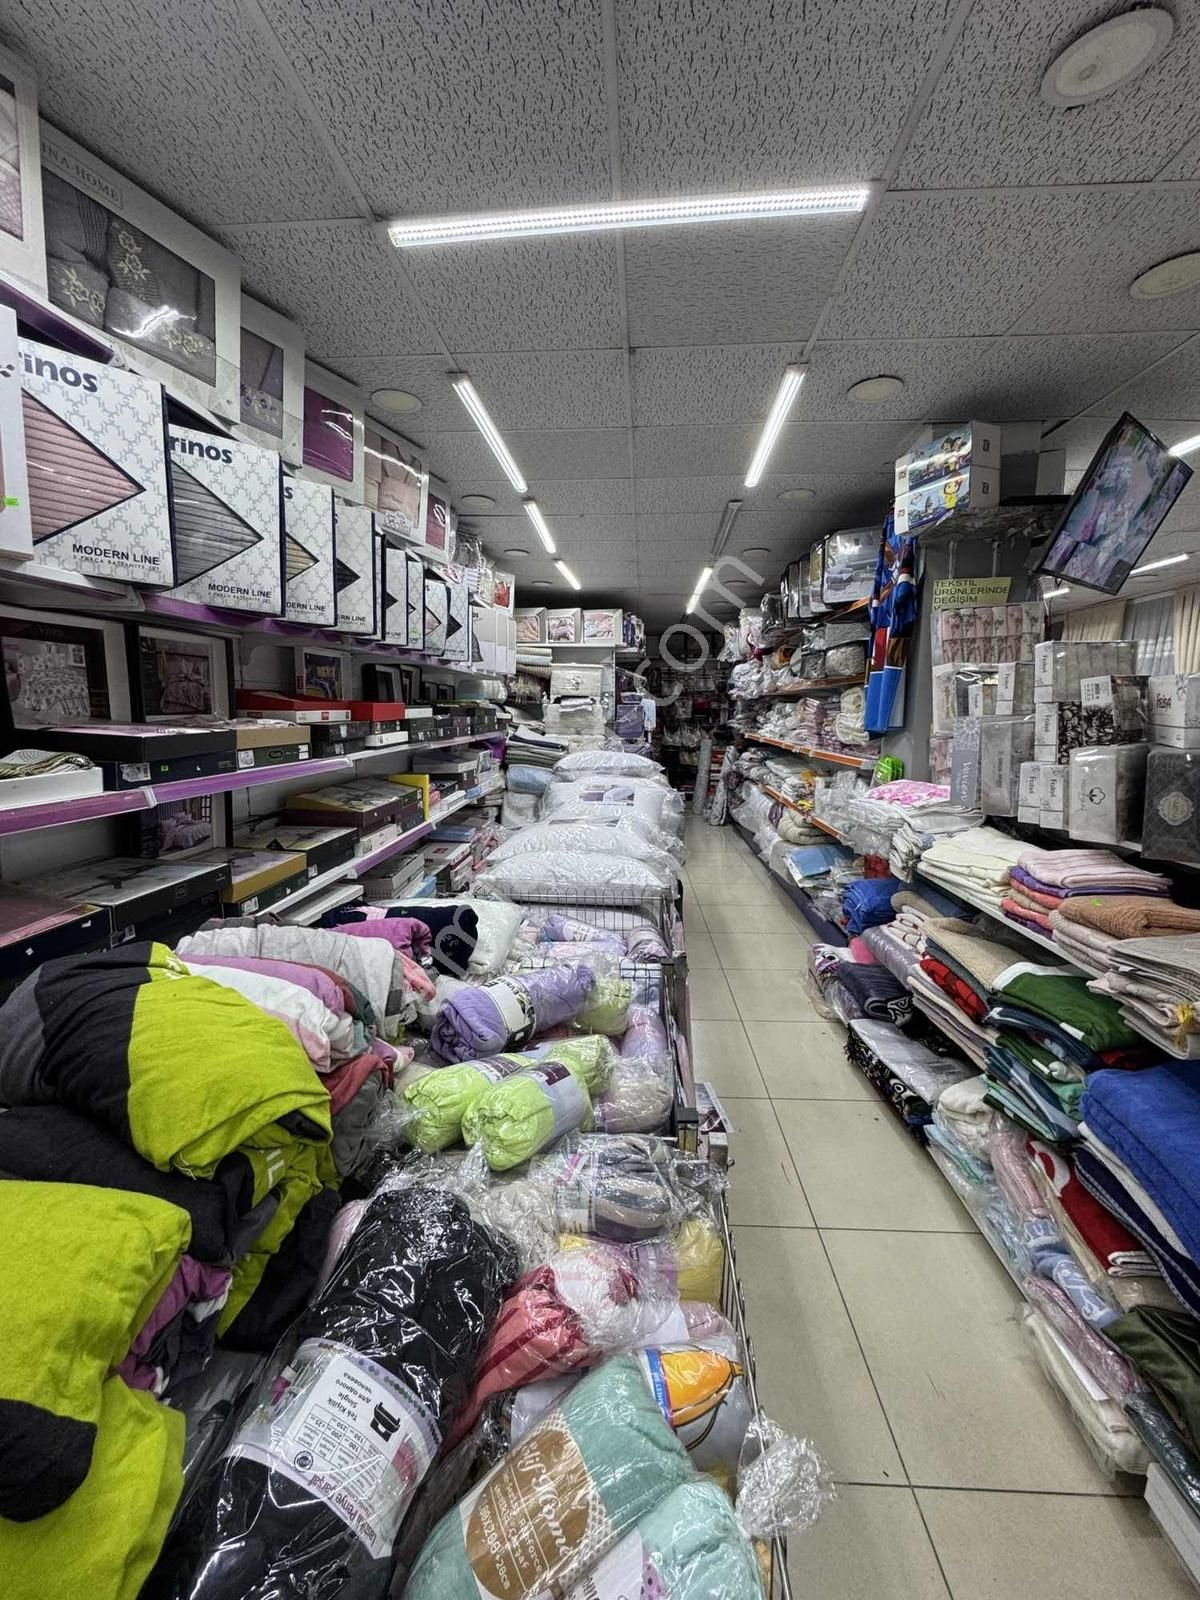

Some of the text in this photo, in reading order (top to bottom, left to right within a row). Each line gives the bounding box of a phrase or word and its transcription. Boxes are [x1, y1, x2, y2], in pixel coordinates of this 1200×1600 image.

[20, 353, 97, 393] inos
[72, 543, 160, 565] MODERN LINE
[208, 583, 249, 595] MODERN
[251, 588, 272, 598] LINE
[326, 1396, 357, 1421] Tek Kişilik
[336, 1391, 357, 1408] Single
[348, 1441, 359, 1451] 100
[334, 1493, 358, 1520] Penye
